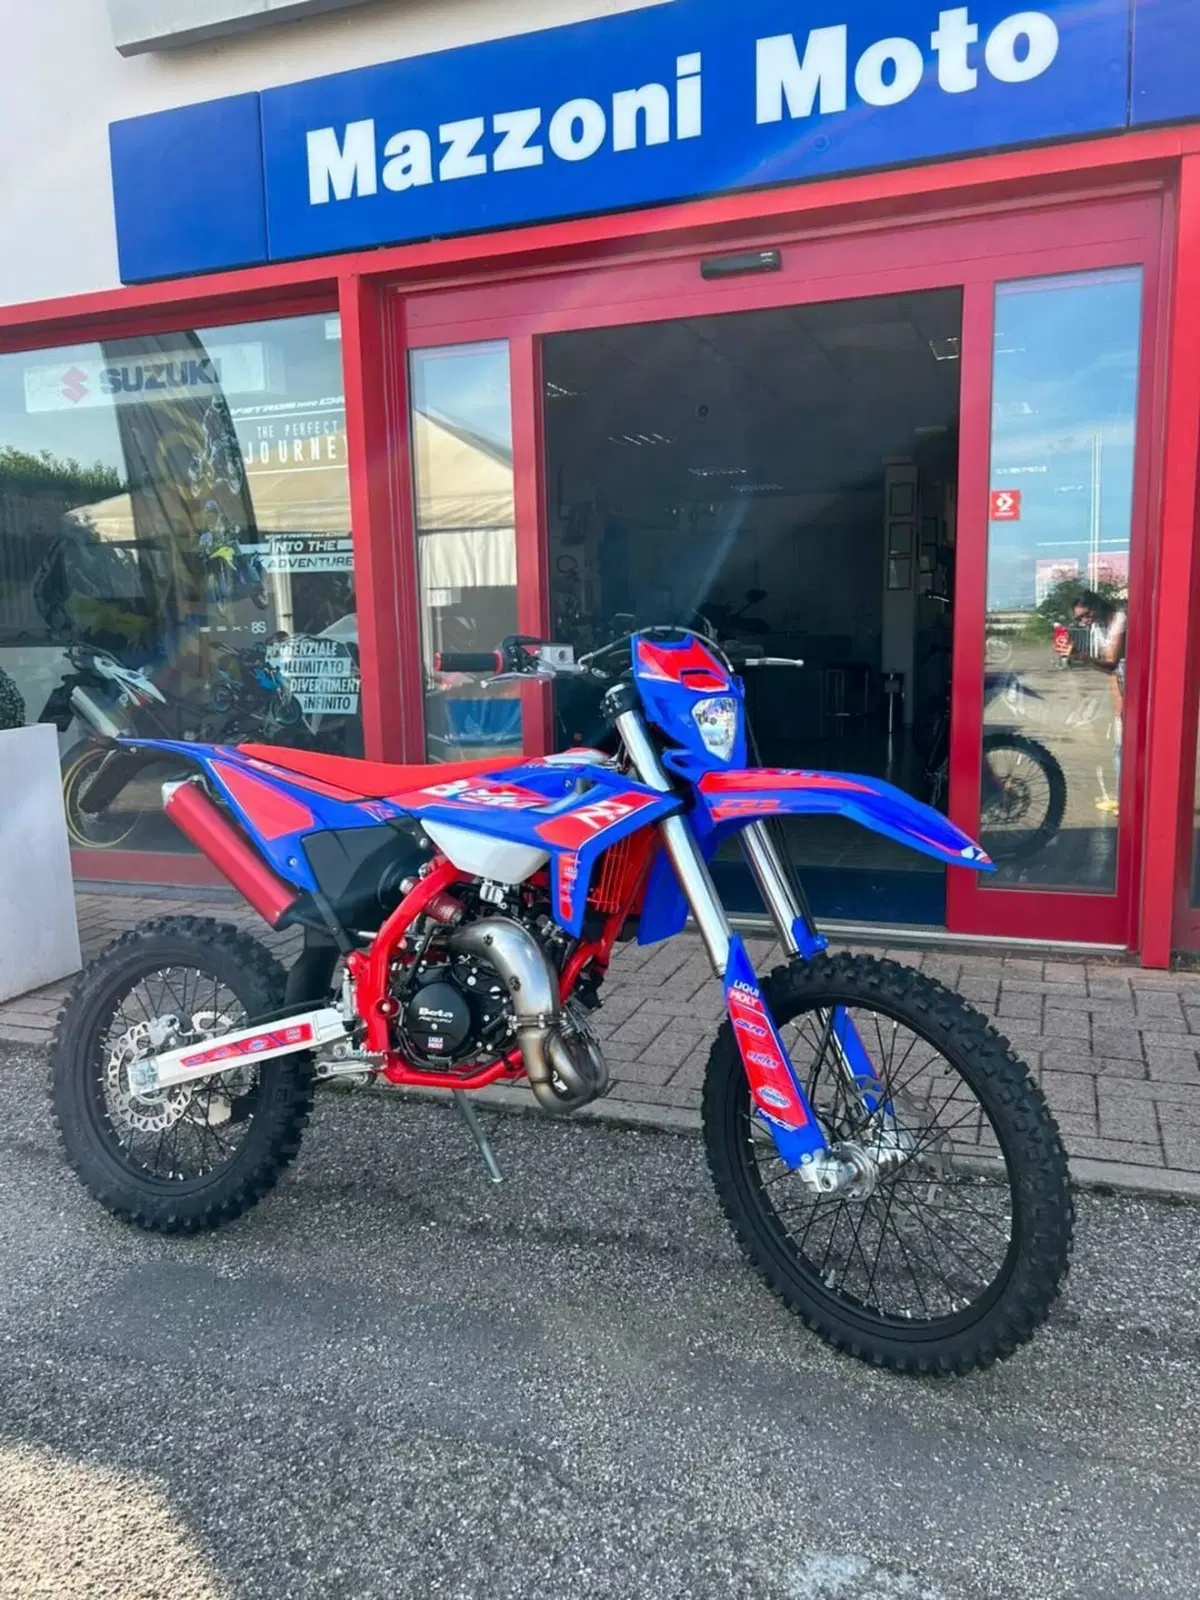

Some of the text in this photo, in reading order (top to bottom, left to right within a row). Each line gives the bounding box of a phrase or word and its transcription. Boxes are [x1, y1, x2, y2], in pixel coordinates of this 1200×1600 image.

[306, 6, 1059, 205] Mazzoni Moto
[99, 358, 221, 394] SUZUKI
[257, 420, 338, 438] THE PERFECT
[271, 540, 336, 554] INTO THE
[267, 556, 354, 568] ADVENTURE
[729, 988, 760, 1007] MOLY
[733, 979, 760, 998] LIQUI
